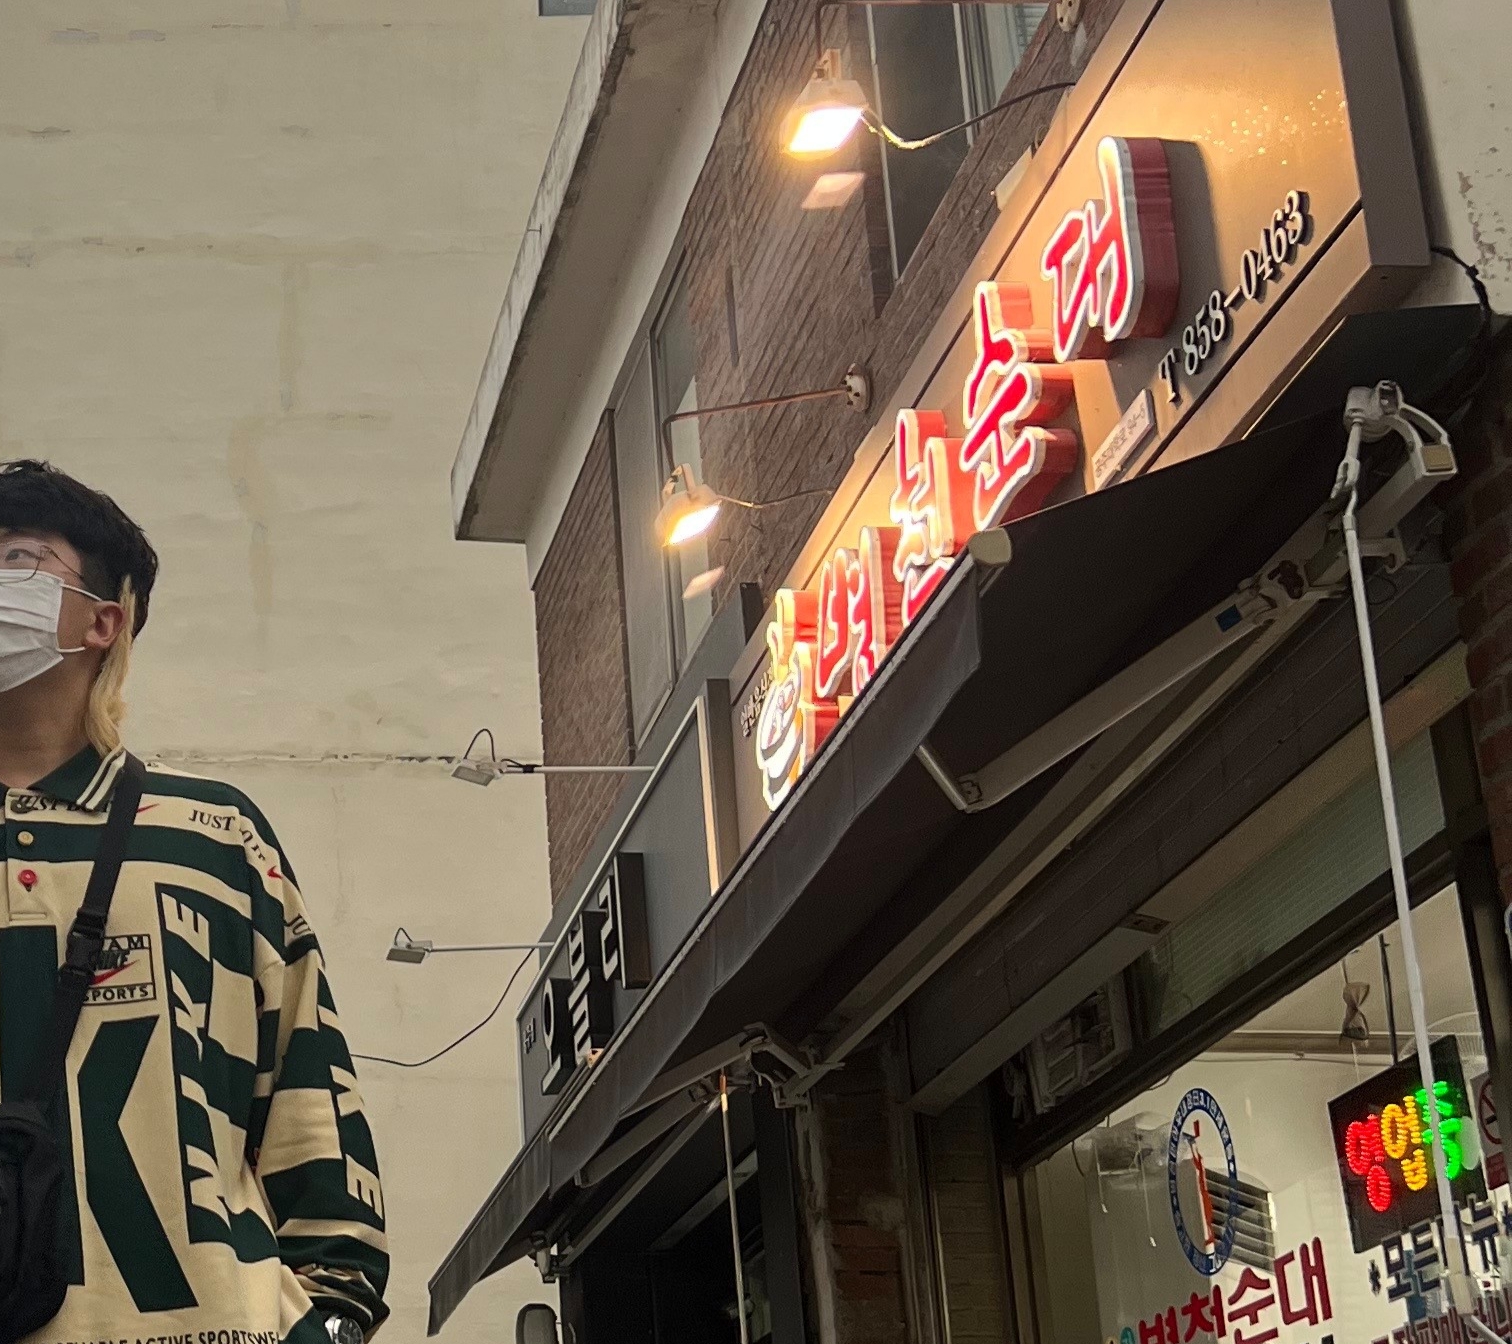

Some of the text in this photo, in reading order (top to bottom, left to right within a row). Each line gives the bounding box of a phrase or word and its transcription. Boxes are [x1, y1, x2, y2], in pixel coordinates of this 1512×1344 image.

[1158, 189, 1310, 404] T 858-0463
[189, 809, 236, 831] JUST
[107, 935, 145, 951] AM
[1345, 1080, 1462, 1213] 영업중
